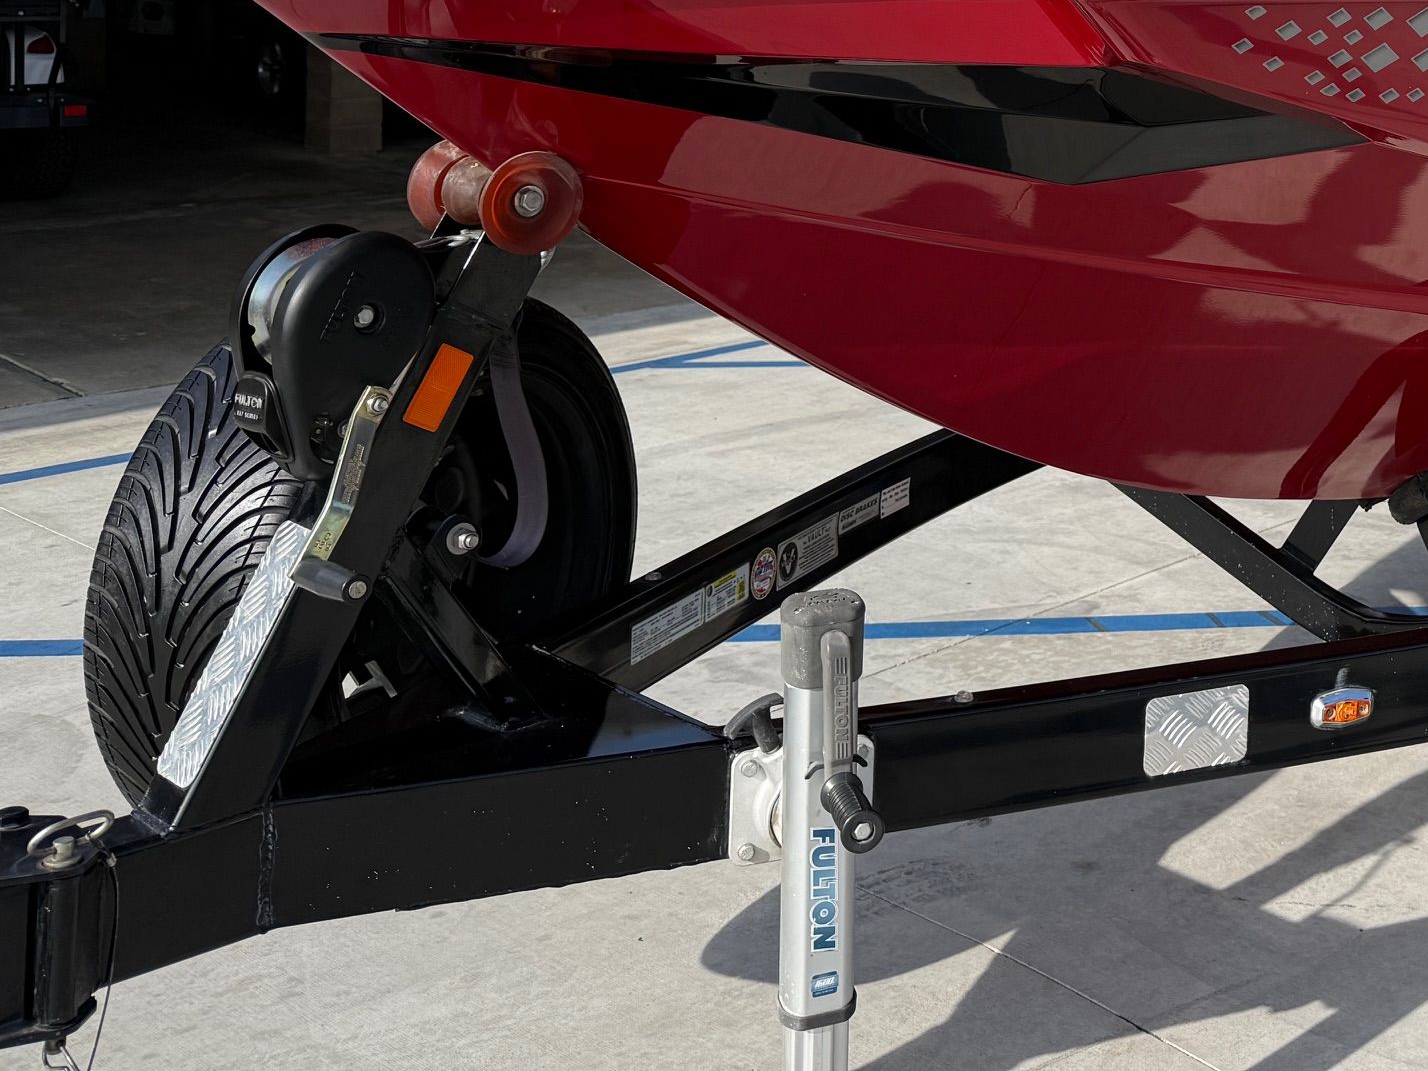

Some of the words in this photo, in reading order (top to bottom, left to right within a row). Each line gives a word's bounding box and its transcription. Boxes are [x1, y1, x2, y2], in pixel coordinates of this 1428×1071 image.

[234, 393, 263, 409] FULTON
[834, 675, 850, 742] FULTON
[810, 827, 839, 952] FULTON
